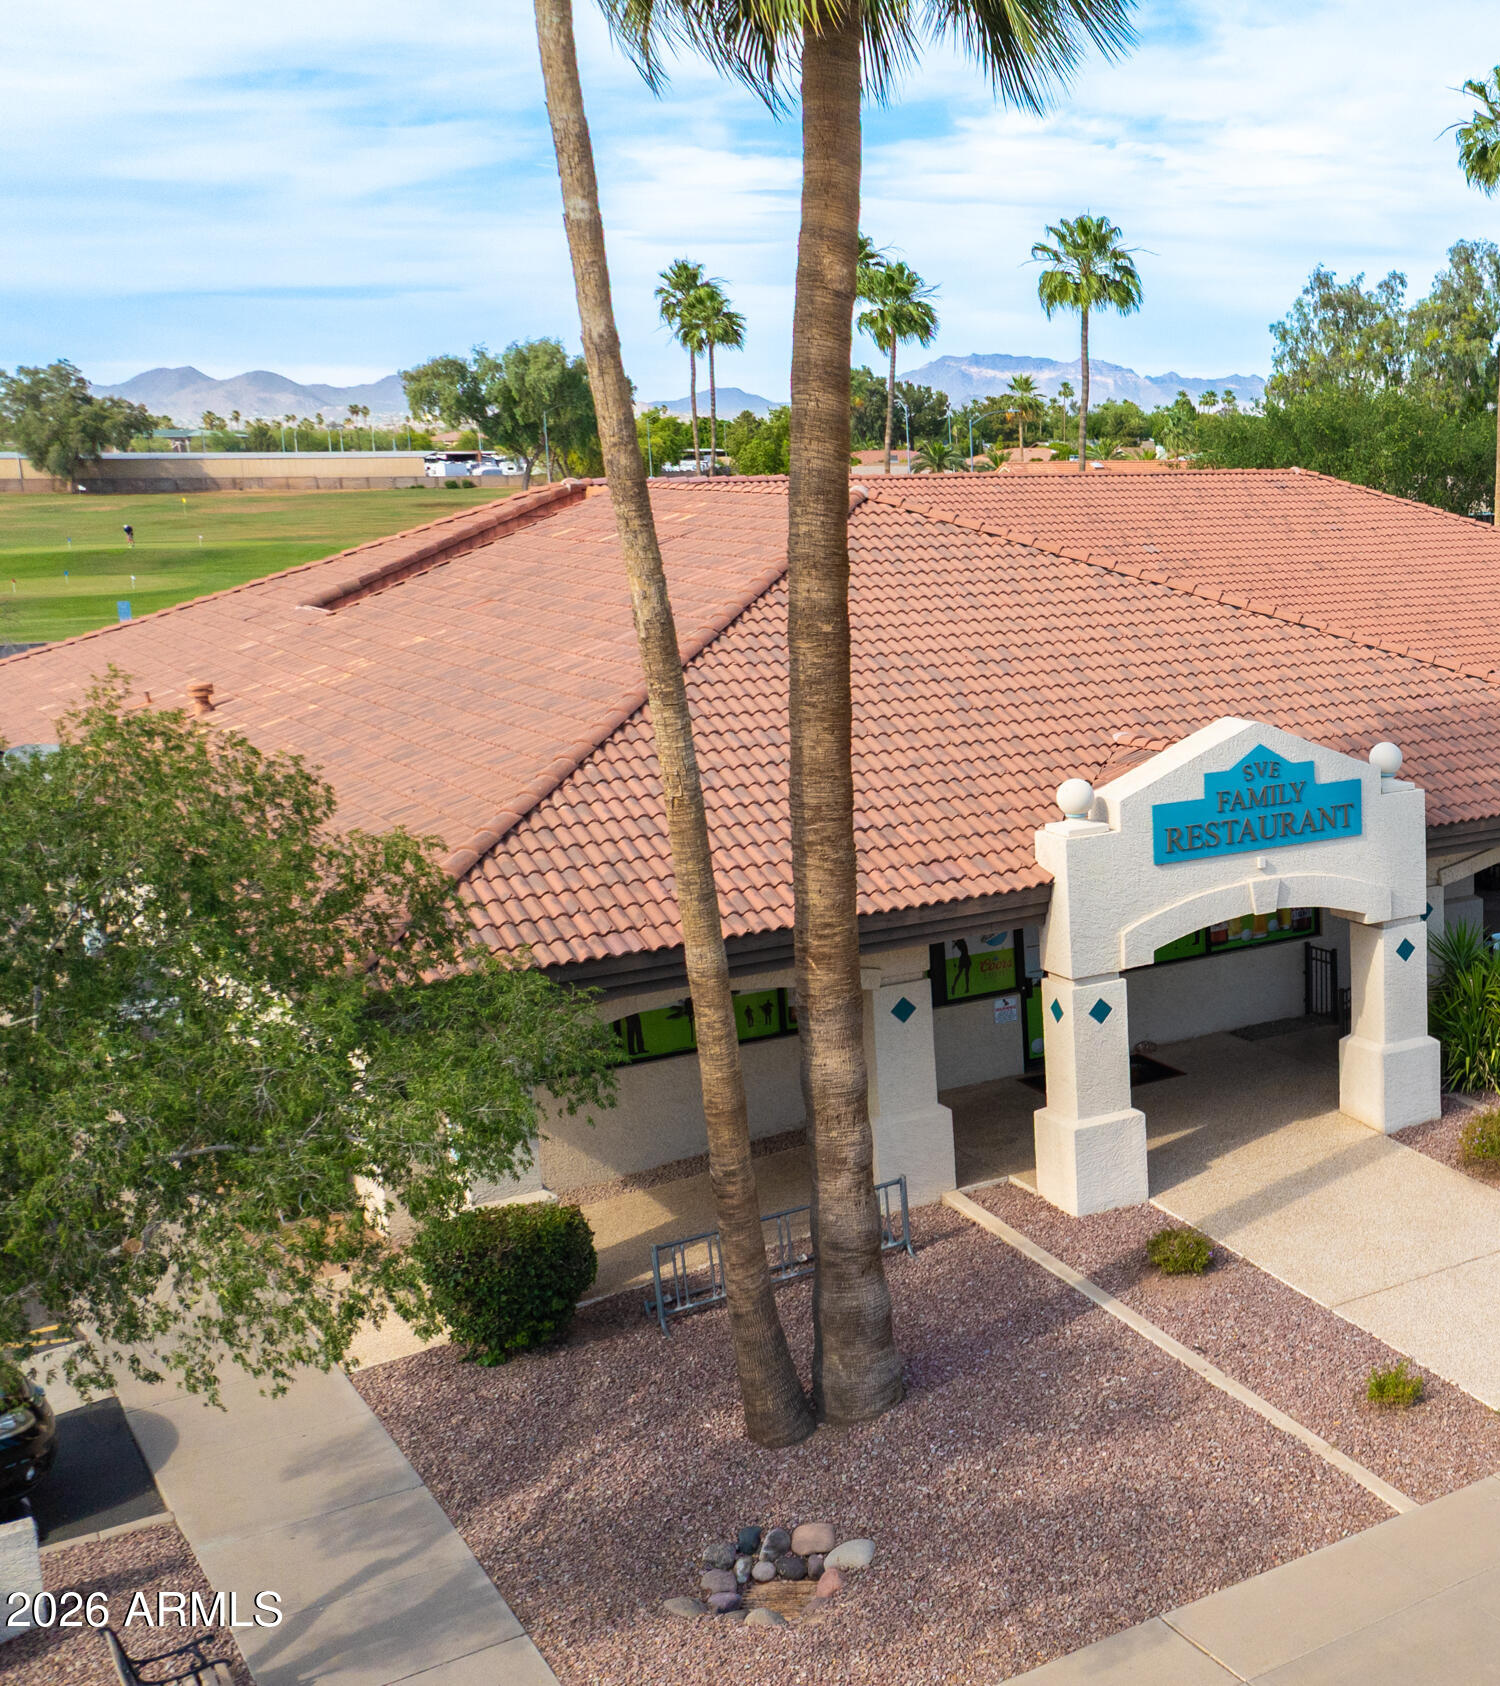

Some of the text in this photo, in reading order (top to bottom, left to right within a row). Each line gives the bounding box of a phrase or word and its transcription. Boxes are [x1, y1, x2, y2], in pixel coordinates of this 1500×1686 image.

[1242, 761, 1280, 782] SVE
[1216, 781, 1306, 813] FAMILY
[1164, 803, 1354, 854] RESTAURANT
[980, 960, 1012, 972] Coors
